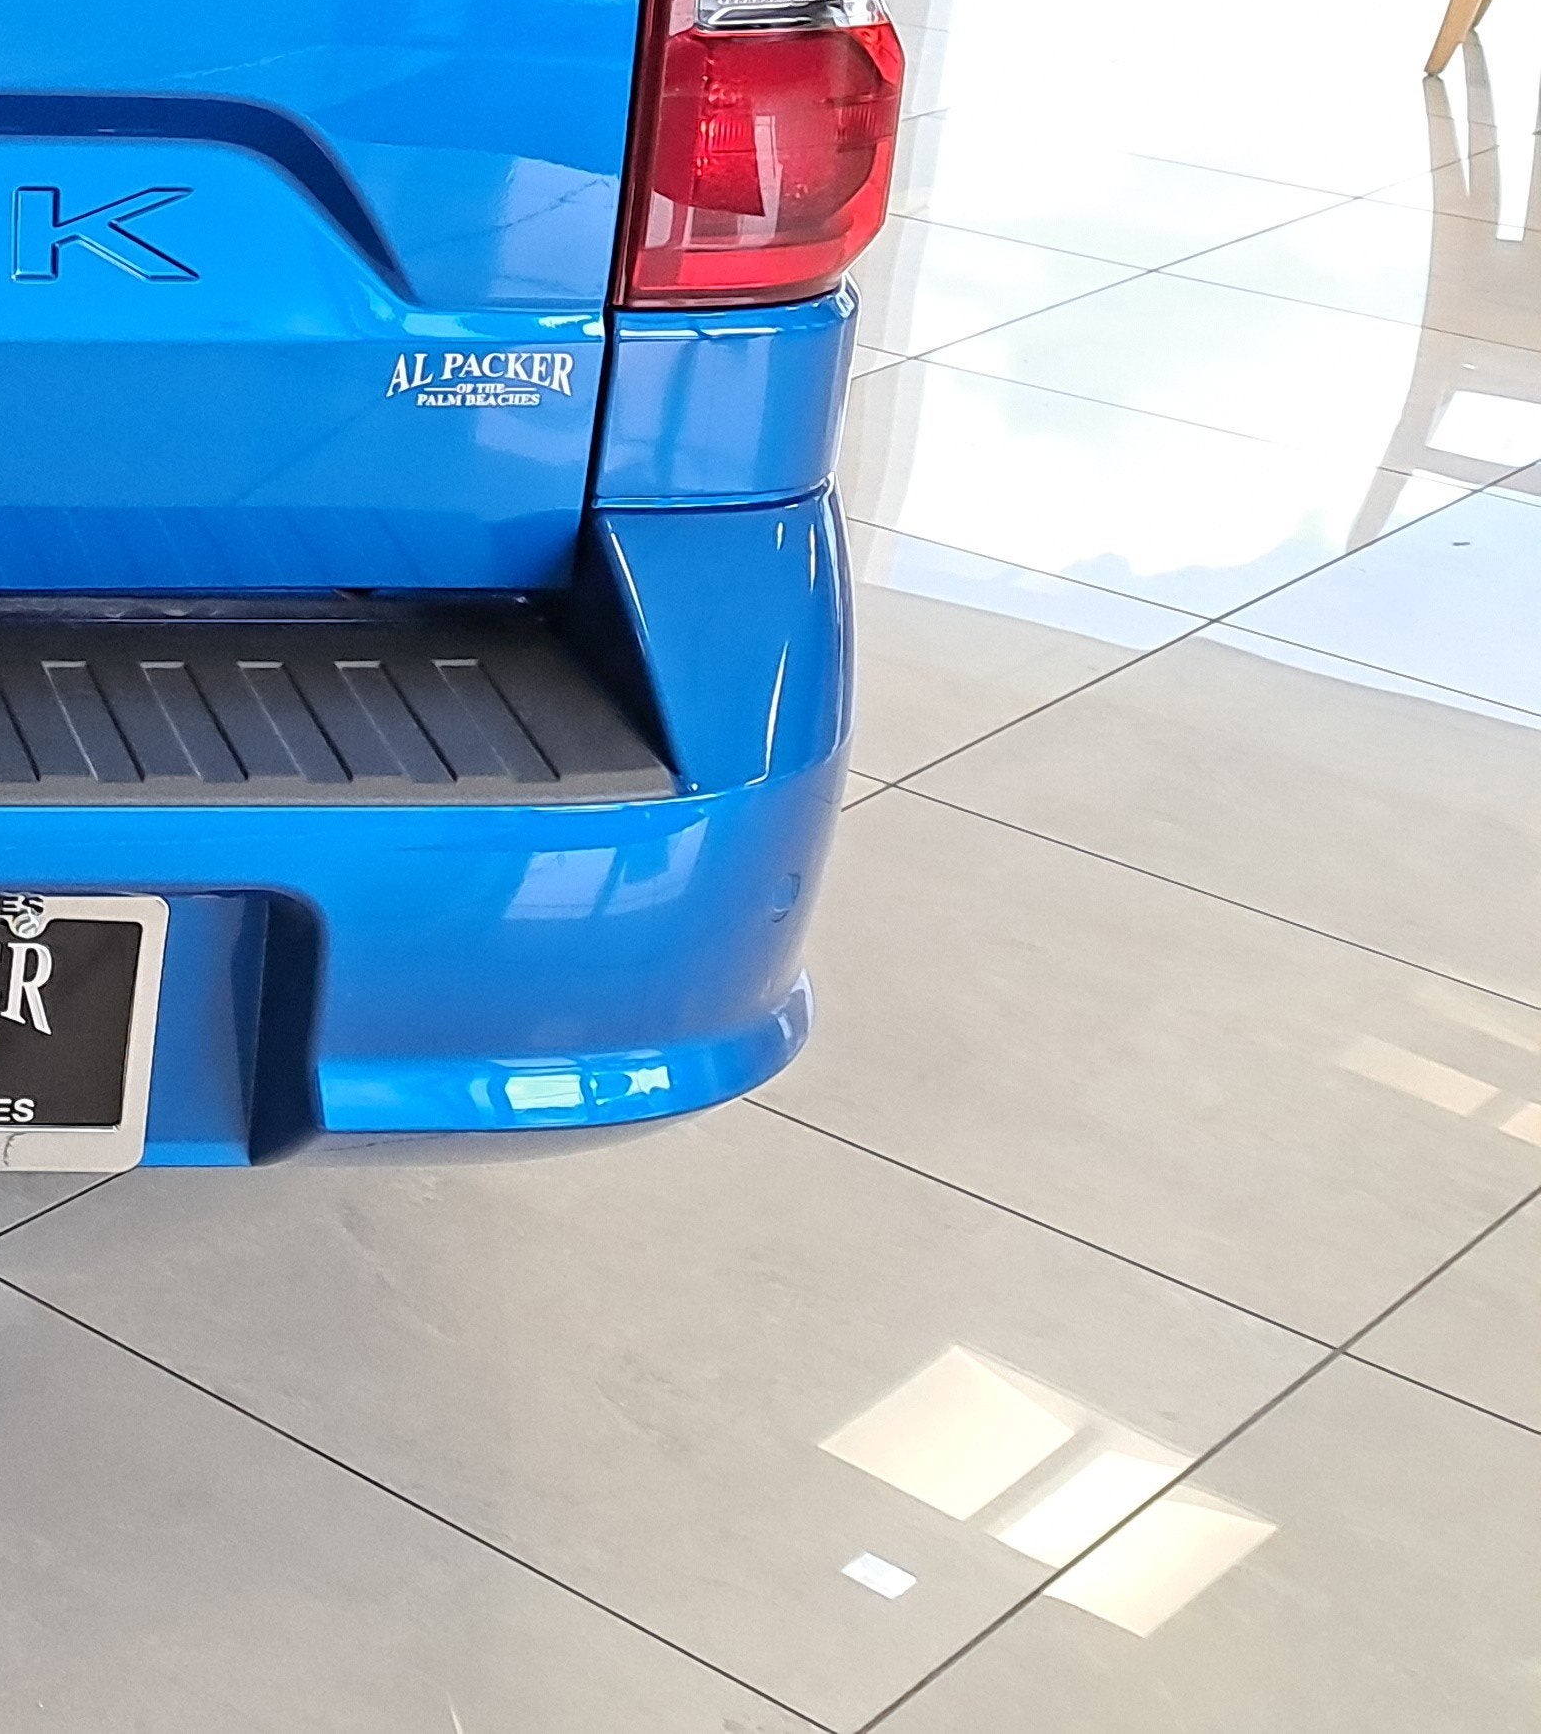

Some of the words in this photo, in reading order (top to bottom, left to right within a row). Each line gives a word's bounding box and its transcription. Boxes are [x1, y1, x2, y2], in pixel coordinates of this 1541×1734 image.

[385, 352, 435, 397] AL
[440, 352, 574, 397] PACKER
[456, 382, 474, 394] OF
[475, 382, 505, 394] THE
[416, 393, 462, 407] PALM
[464, 393, 541, 407] BEACHES
